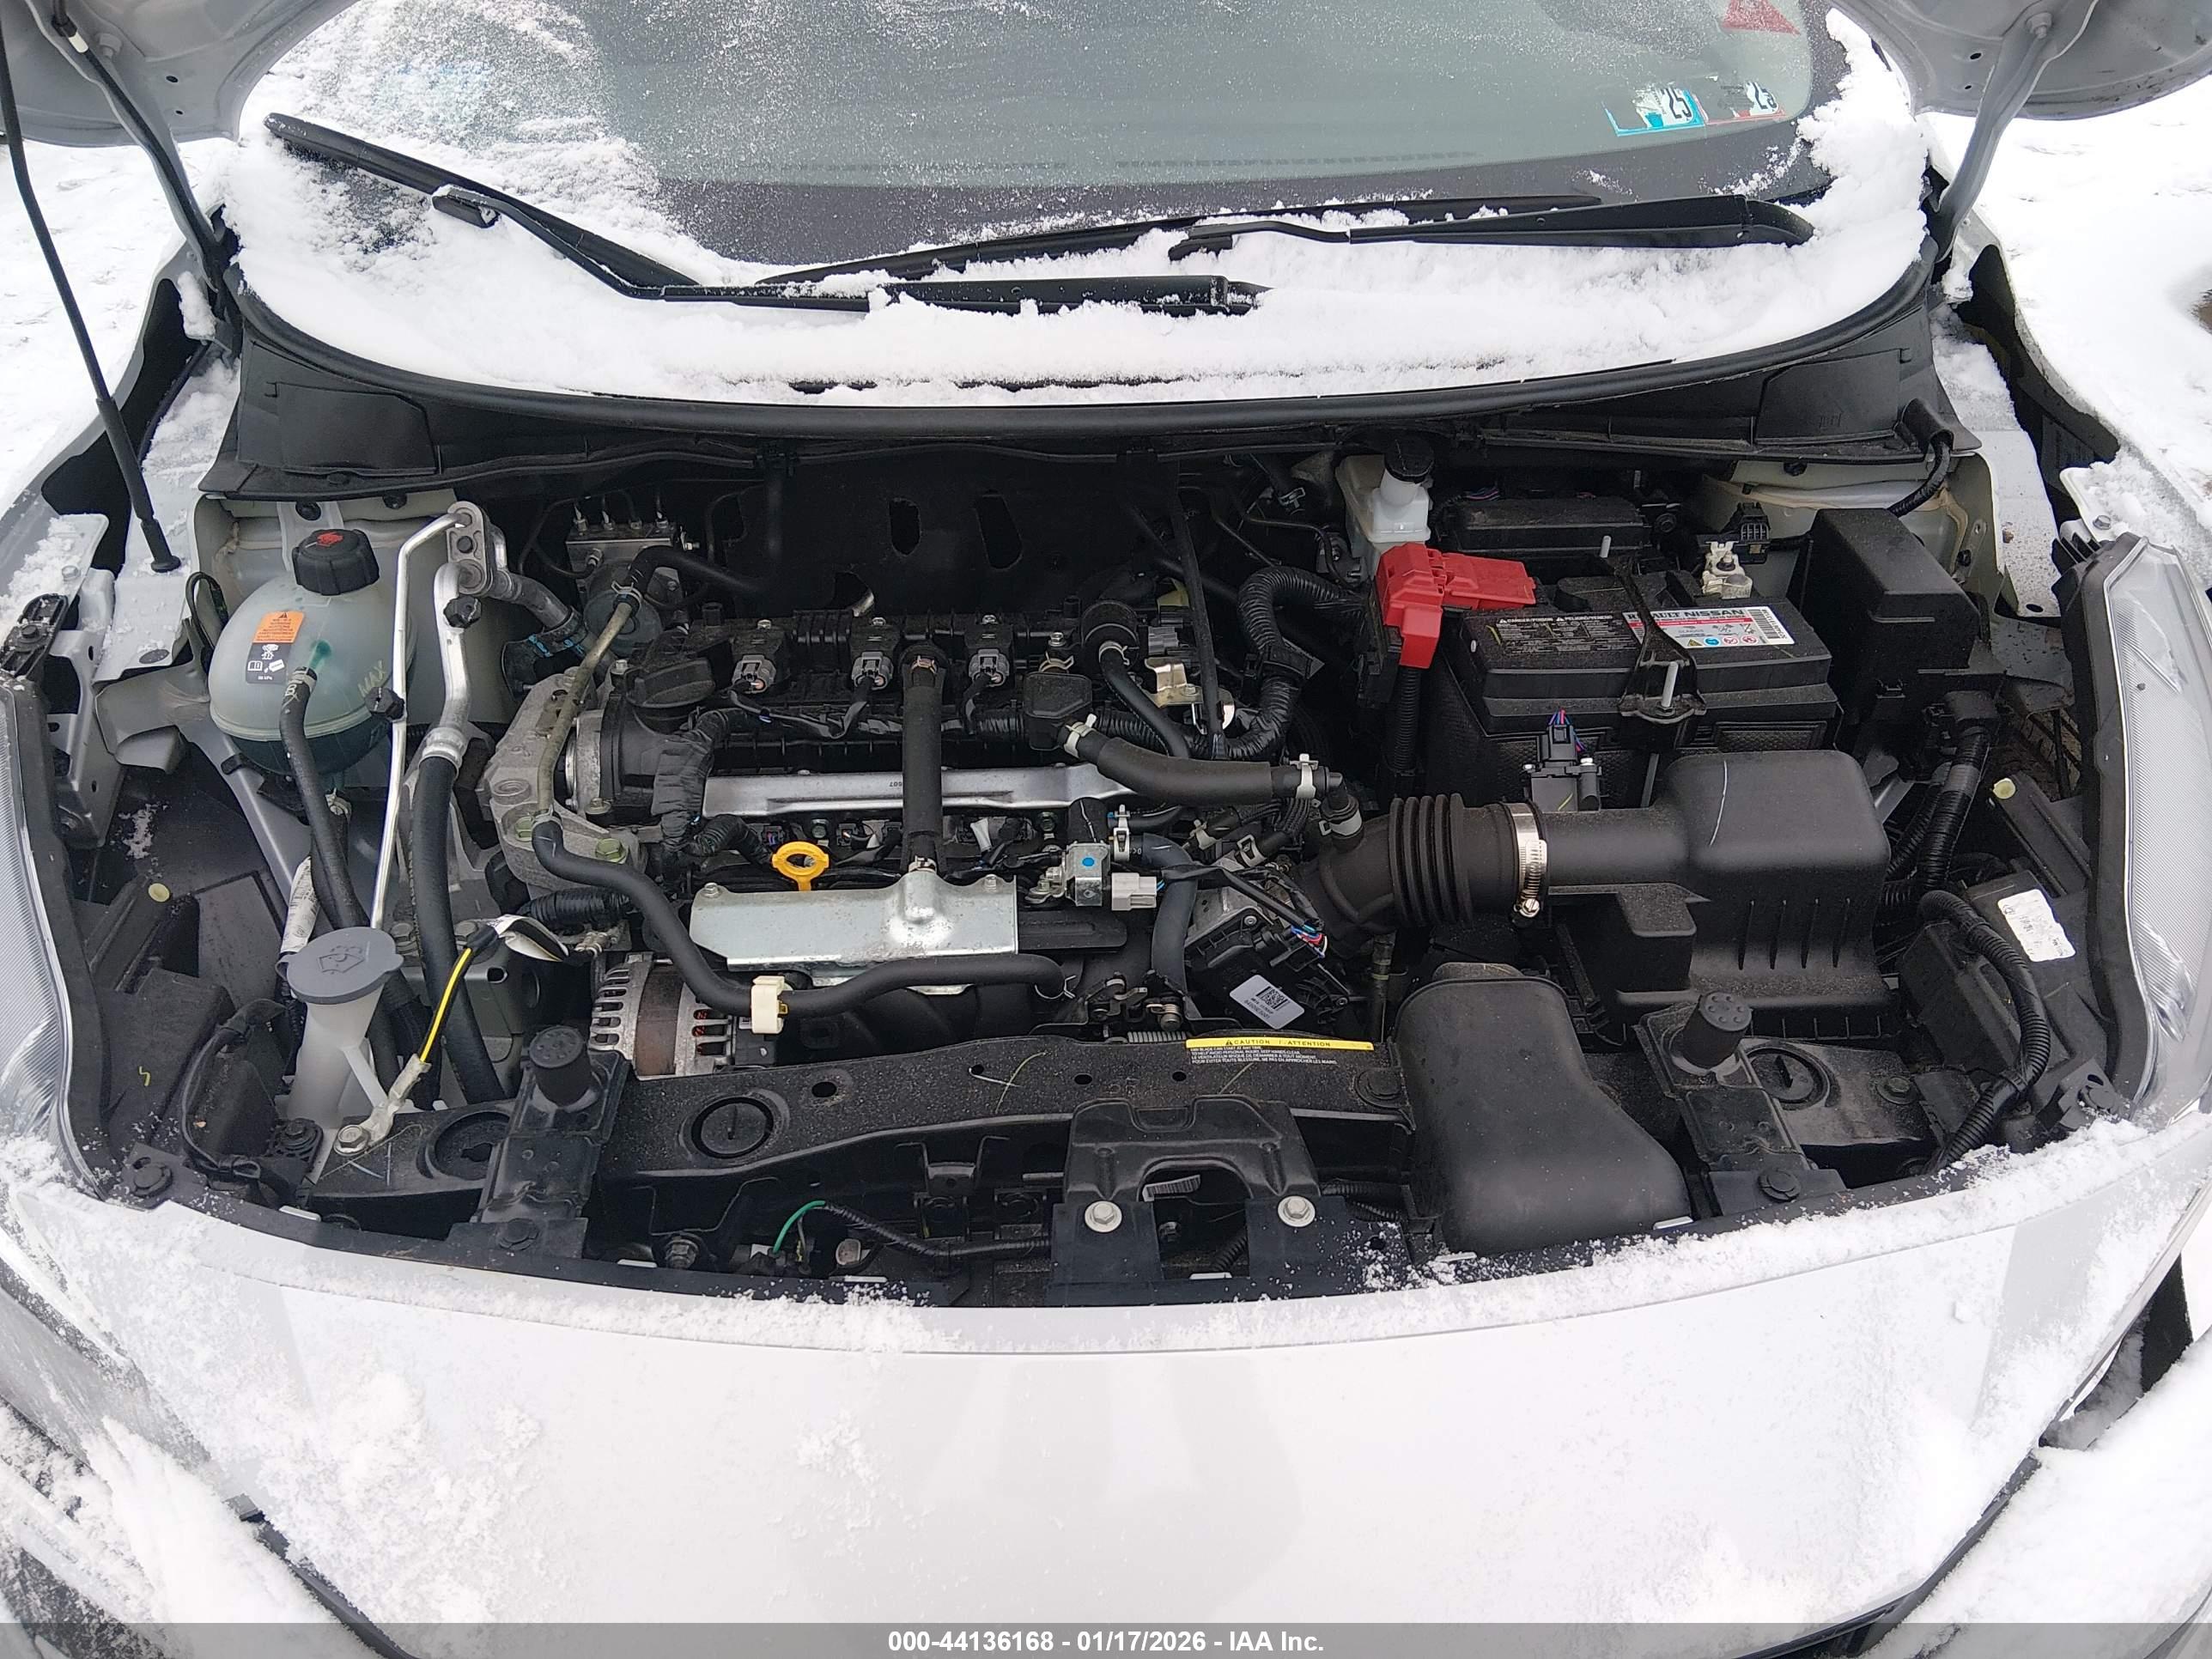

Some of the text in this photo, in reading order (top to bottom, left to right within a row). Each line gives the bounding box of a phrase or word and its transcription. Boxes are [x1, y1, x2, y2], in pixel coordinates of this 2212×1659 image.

[1661, 88, 1692, 119] 25
[1627, 611, 1680, 620] RAULT
[1684, 609, 1745, 617] NISSAN
[356, 659, 383, 699] MAX
